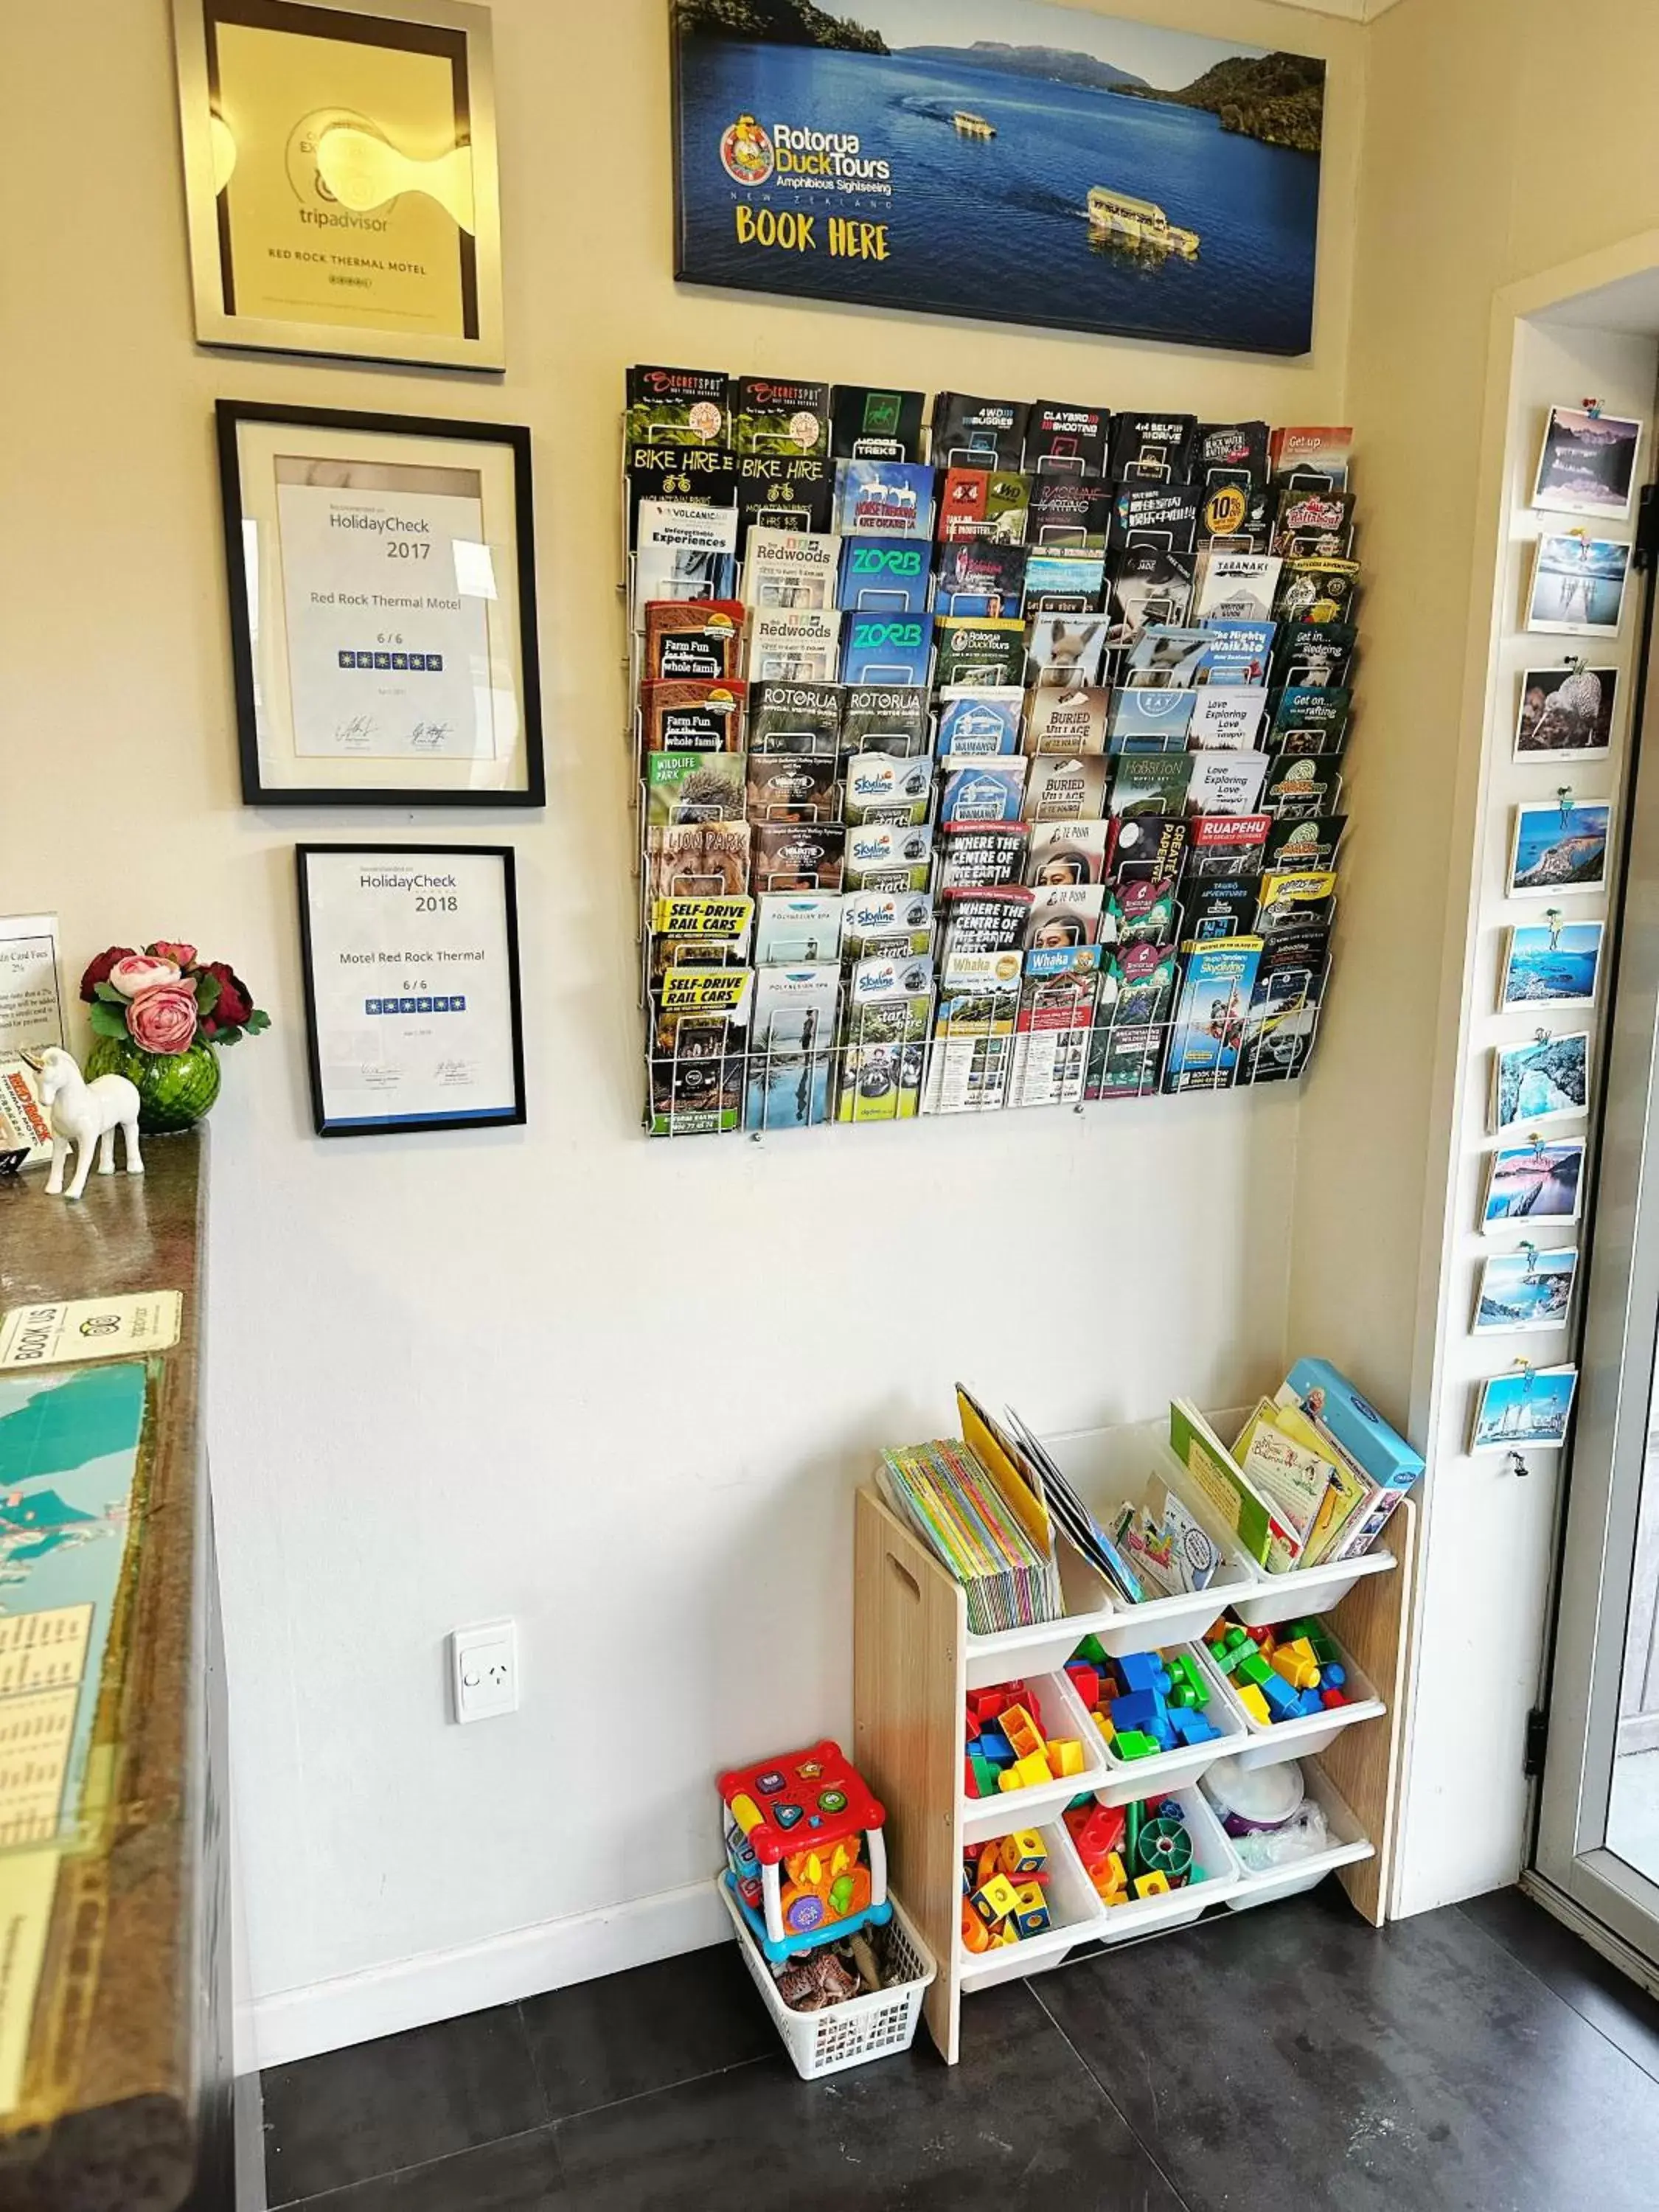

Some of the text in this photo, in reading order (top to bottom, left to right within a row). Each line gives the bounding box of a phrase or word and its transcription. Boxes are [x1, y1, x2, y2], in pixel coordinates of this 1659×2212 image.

[774, 125, 859, 153] Rotorua
[777, 175, 891, 195] Amphibious Sightseeing
[299, 208, 389, 232] tripadvisor
[736, 205, 891, 260] BOOK HERE
[268, 248, 426, 276] RED ROCK THERMAL MOTEL
[635, 449, 718, 473] BIKE HIRE
[742, 459, 824, 481] BIKE HIRE
[673, 509, 715, 520] VOLCANIC
[1211, 496, 1231, 520] 10
[330, 515, 430, 535] HolidayCheck
[653, 532, 726, 547] Experiences
[386, 542, 430, 559] 2017
[757, 546, 831, 563] Redwoods
[852, 549, 921, 576] ZORB
[1217, 561, 1268, 571] TARANAKI
[310, 592, 462, 611] Red Rock Thermal Motel
[759, 623, 832, 639] Redwoods
[853, 623, 922, 648] ZORB
[970, 631, 1001, 641] Rotorua
[1215, 630, 1266, 644] The Mighty
[1297, 632, 1312, 643] Get
[664, 639, 709, 653] Farm Fun
[1209, 640, 1263, 653] Waikato
[664, 661, 690, 673] whole
[764, 689, 838, 709] ROTORUA
[851, 693, 920, 709] ROTORUA
[1208, 700, 1227, 709] Love
[1293, 695, 1310, 706] Get
[1051, 712, 1090, 724] BURIED
[1206, 710, 1247, 720] Exploring
[1304, 706, 1336, 720] rafting
[667, 717, 711, 727] Farm Fun
[1218, 720, 1239, 728] Love
[1046, 726, 1090, 737] VILLAGE
[667, 737, 692, 746] whole
[658, 757, 695, 770] WILDLIFE
[855, 774, 892, 793] Skyline
[1046, 779, 1085, 791] BURIED
[1204, 776, 1248, 785] Exploring
[1042, 791, 1085, 802] VILLAGE
[1203, 821, 1265, 834] RUAPEHU
[669, 832, 745, 850] LION PARK
[955, 837, 1020, 850] WHERE THE
[853, 841, 891, 859] Skyline
[1165, 825, 1186, 873] CREATE
[953, 852, 1014, 864] CENTRE OF
[360, 874, 456, 891] HolidayCheck
[415, 896, 458, 912] 2018
[669, 903, 745, 917] SELF-DRIVE
[960, 902, 1026, 918] WHERE THE
[858, 907, 895, 927] Skyline
[957, 917, 1019, 931] CENTRE OF
[669, 919, 737, 931] RAIL CARS
[976, 931, 1015, 944] EARTH
[339, 950, 484, 964] Motel Red Rock Thermal
[1033, 954, 1068, 968] Whaka
[953, 959, 990, 971] Whaka
[669, 977, 742, 991] SELF-DRIVE
[859, 973, 894, 992] Skyline
[667, 990, 734, 1004] RAIL CARS
[877, 1009, 913, 1023] starts
[14, 1309, 57, 1360] BOOK US
